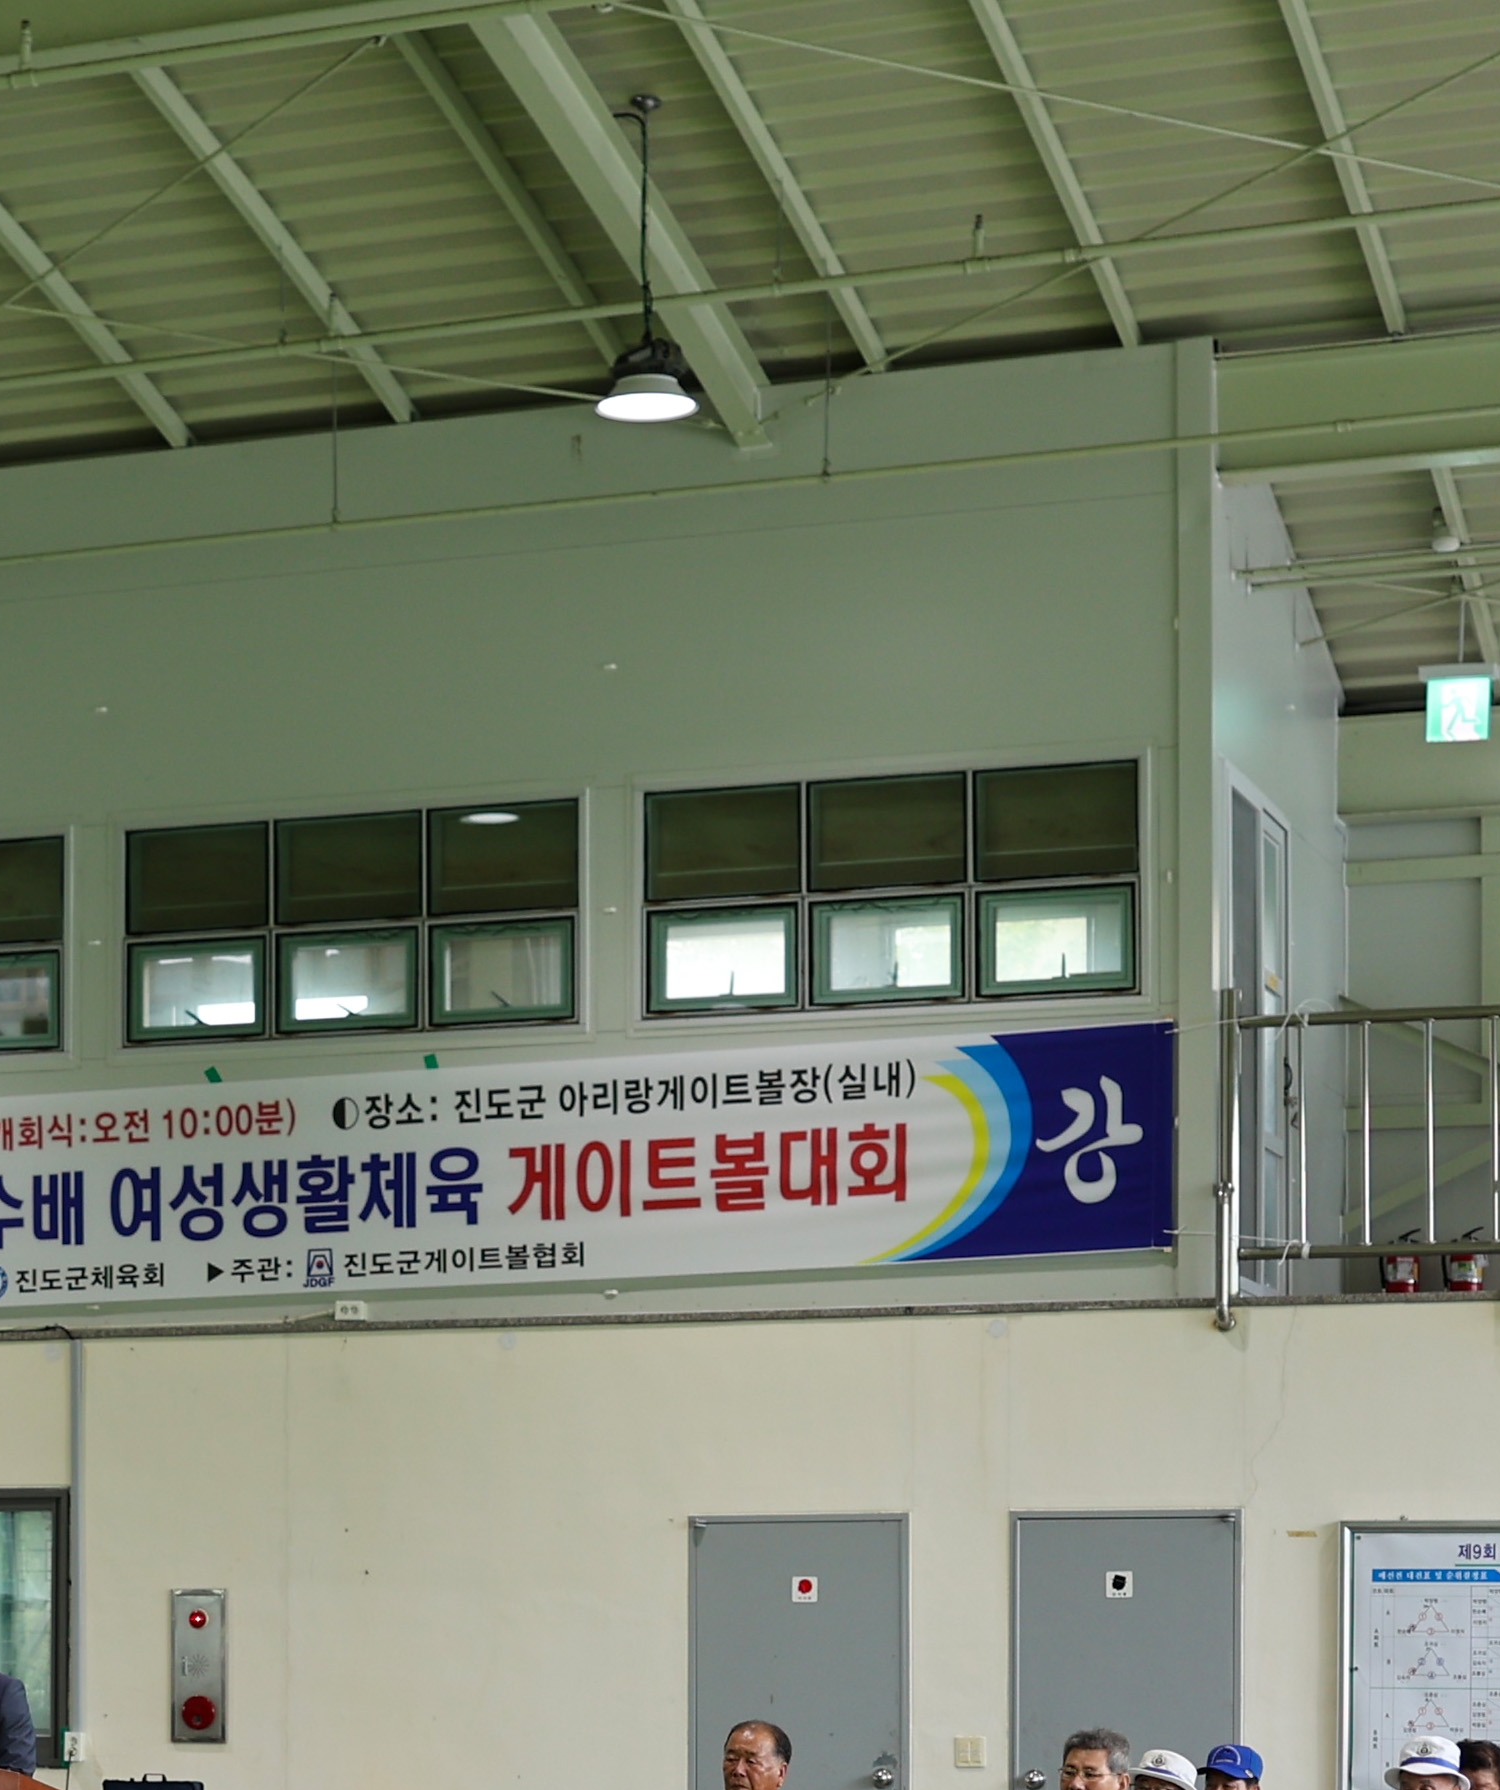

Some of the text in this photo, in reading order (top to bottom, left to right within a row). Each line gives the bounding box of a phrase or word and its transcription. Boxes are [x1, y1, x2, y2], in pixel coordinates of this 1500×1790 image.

[364, 1059, 916, 1129] 장소: 진도군 아리랑게이트볼장(실내)
[162, 1098, 296, 1139] 10:00분)
[1035, 1075, 1143, 1204] 강
[110, 1147, 482, 1241] 여성생활체육
[508, 1122, 907, 1221] 게이트볼대회
[16, 1263, 165, 1293] 진도군체육회
[231, 1241, 585, 1283] 주관: 진도군게이트볼협회
[303, 1277, 335, 1288] JDGF
[1458, 1543, 1497, 1561] 제9회
